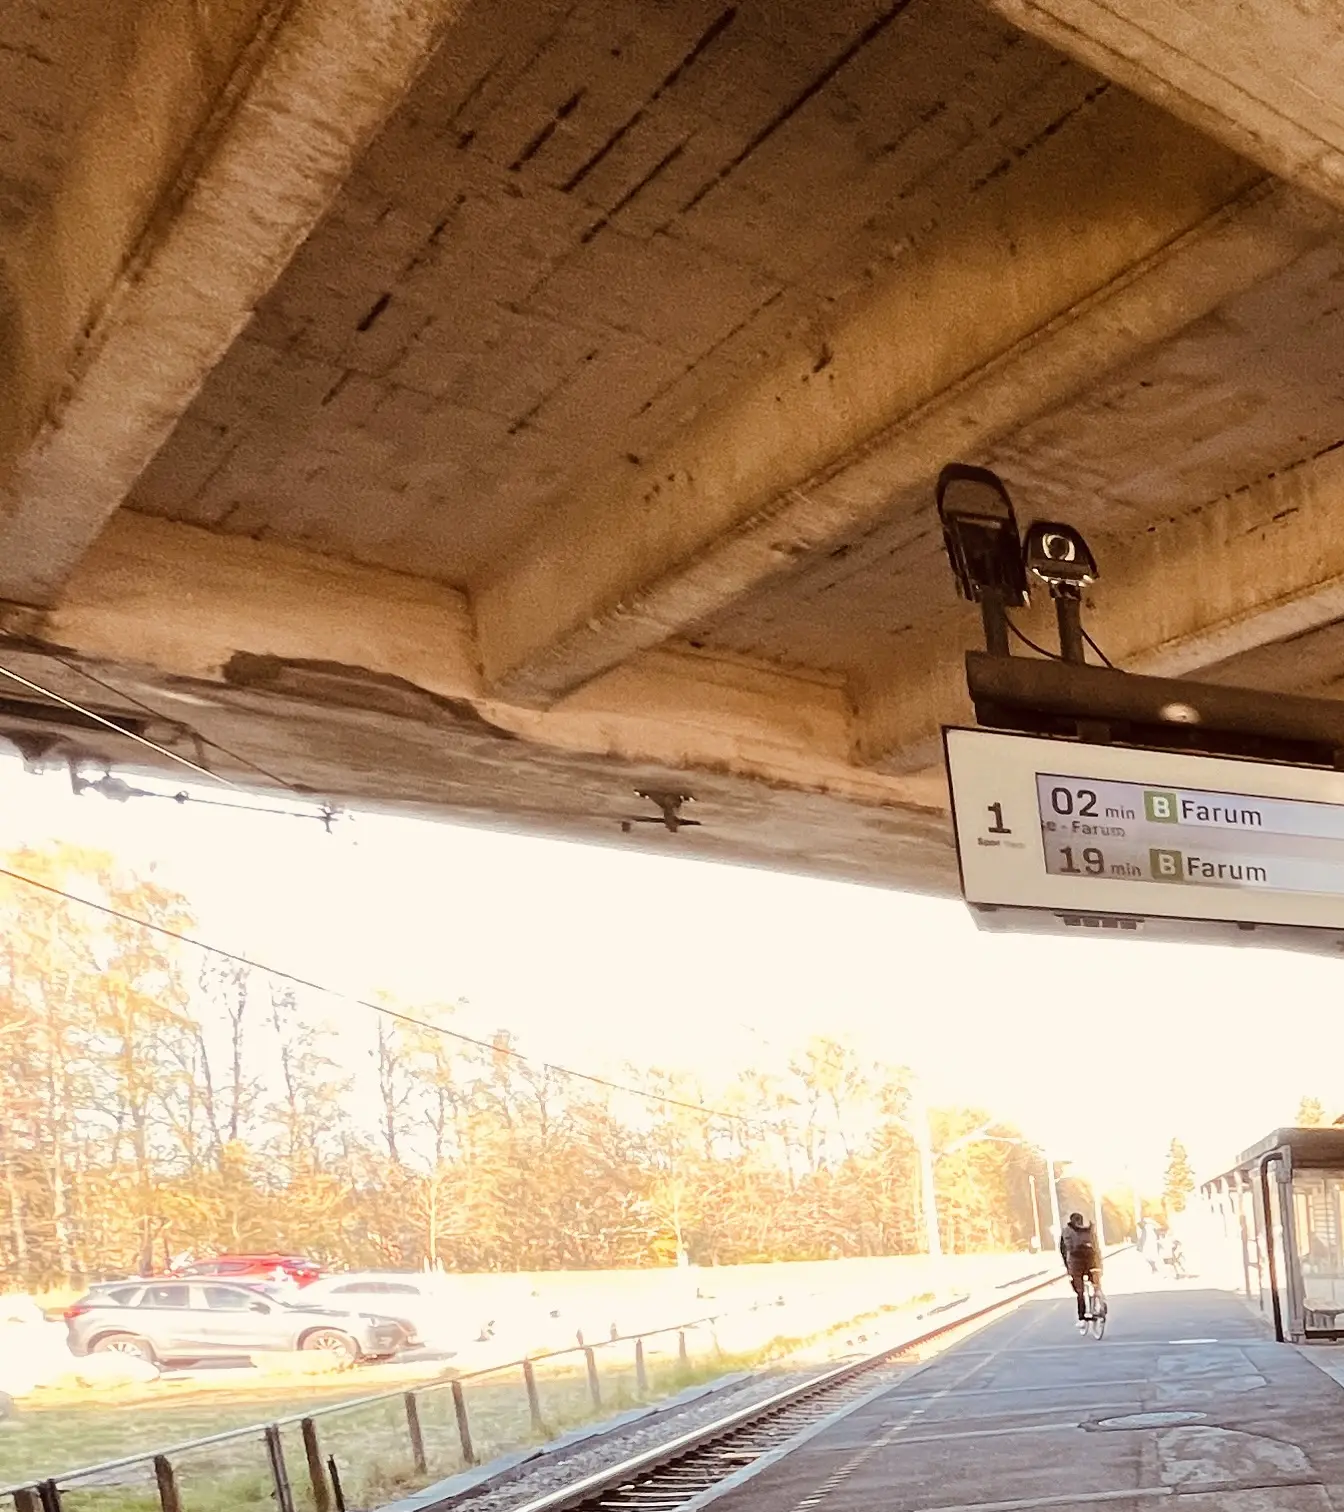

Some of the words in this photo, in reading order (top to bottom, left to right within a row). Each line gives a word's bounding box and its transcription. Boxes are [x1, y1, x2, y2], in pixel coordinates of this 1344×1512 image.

[987, 801, 1012, 834] 1
[1051, 787, 1099, 817] 02
[1105, 805, 1136, 820] min
[1152, 796, 1171, 818] B
[1181, 799, 1262, 826] Farum
[1071, 820, 1126, 838] Farum
[1059, 845, 1105, 876] 19
[1110, 861, 1142, 877] min
[1158, 853, 1176, 875] B
[1186, 855, 1267, 882] Farum
